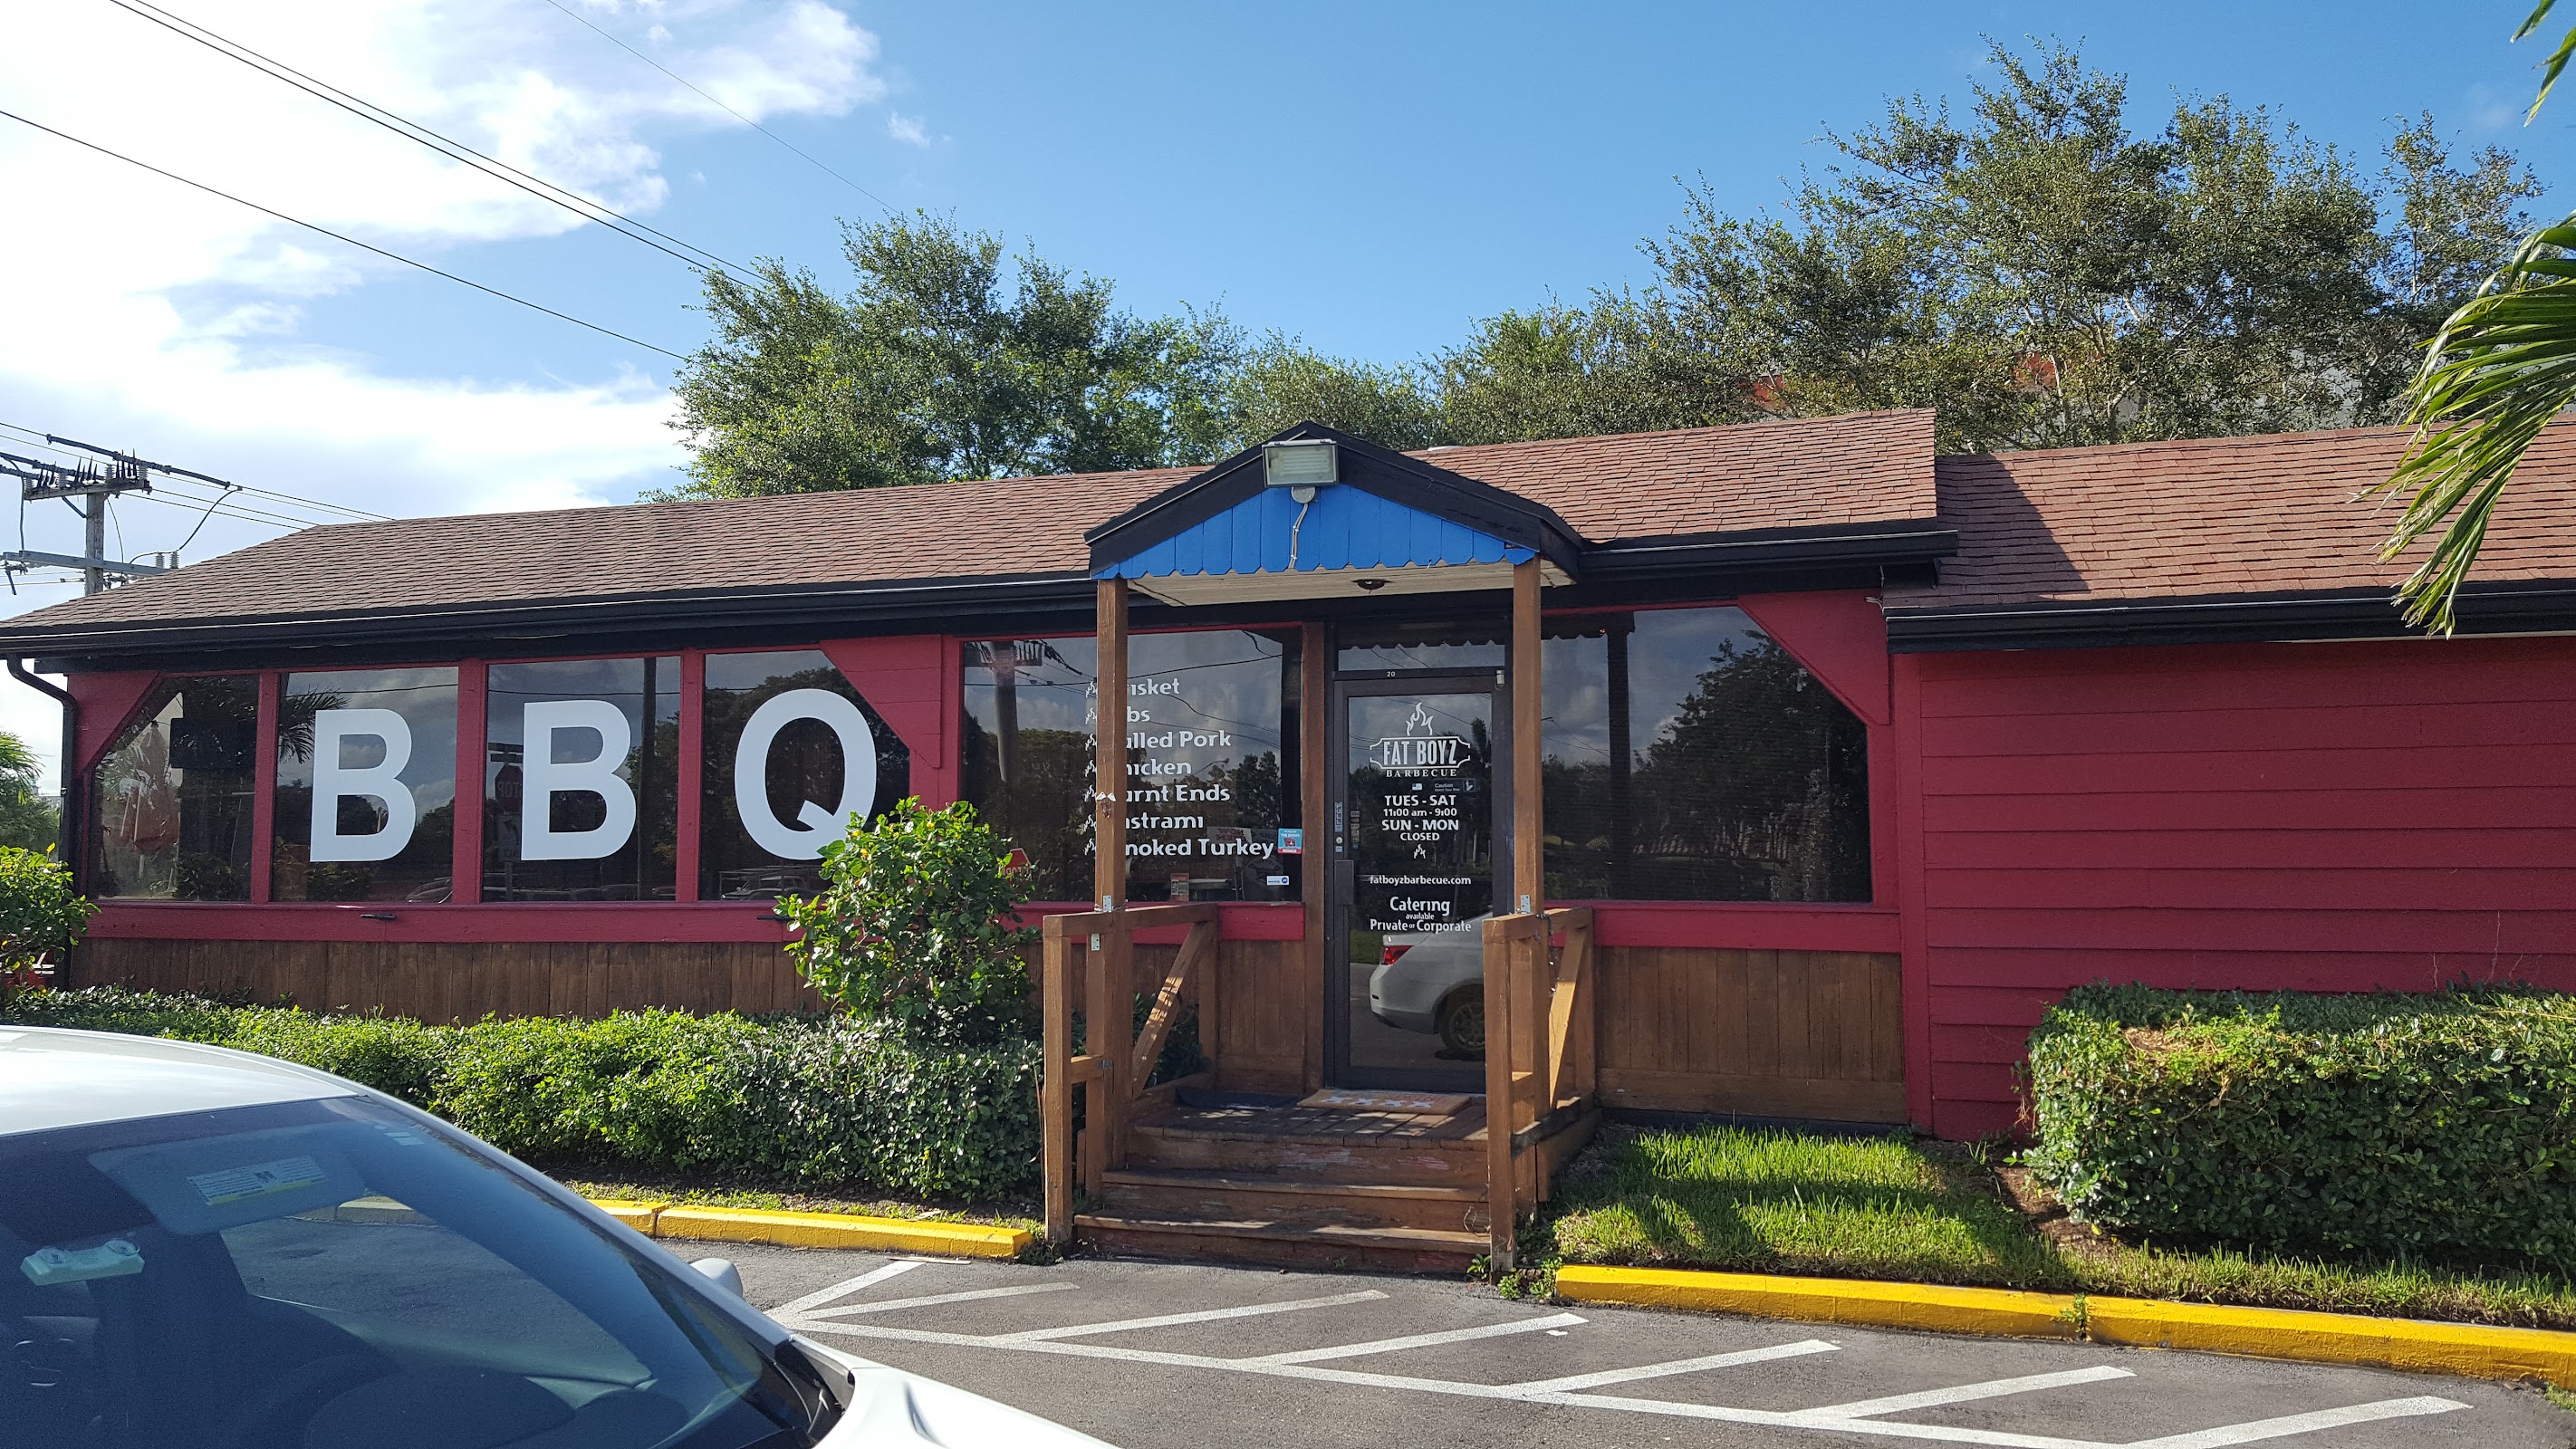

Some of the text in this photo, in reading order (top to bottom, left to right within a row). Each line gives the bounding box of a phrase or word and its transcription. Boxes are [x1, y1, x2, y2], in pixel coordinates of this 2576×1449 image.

[1127, 677, 1180, 696] isket
[1127, 705, 1150, 722] bs
[1127, 729, 1232, 748] lled Pork
[1383, 740, 1457, 765] FAT BOYZ
[1127, 758, 1192, 775] icken
[1386, 769, 1457, 778] BARBECUE
[1127, 784, 1231, 802] rnt Ends
[1384, 795, 1419, 806] TUES
[1429, 794, 1456, 806] SAT
[1126, 812, 1204, 830] strami
[1383, 809, 1409, 817] 11:00
[1434, 808, 1457, 817] 9:00
[1381, 820, 1411, 830] SUN
[1422, 819, 1459, 830] MON
[1399, 832, 1440, 841] CLOSED
[1197, 838, 1274, 860] Turkey
[1370, 875, 1472, 886] fatboyzbarbecue.com
[1389, 896, 1451, 916] Catering
[1405, 912, 1435, 920] available
[1370, 918, 1408, 932] Private
[1417, 919, 1472, 935] Corporate
